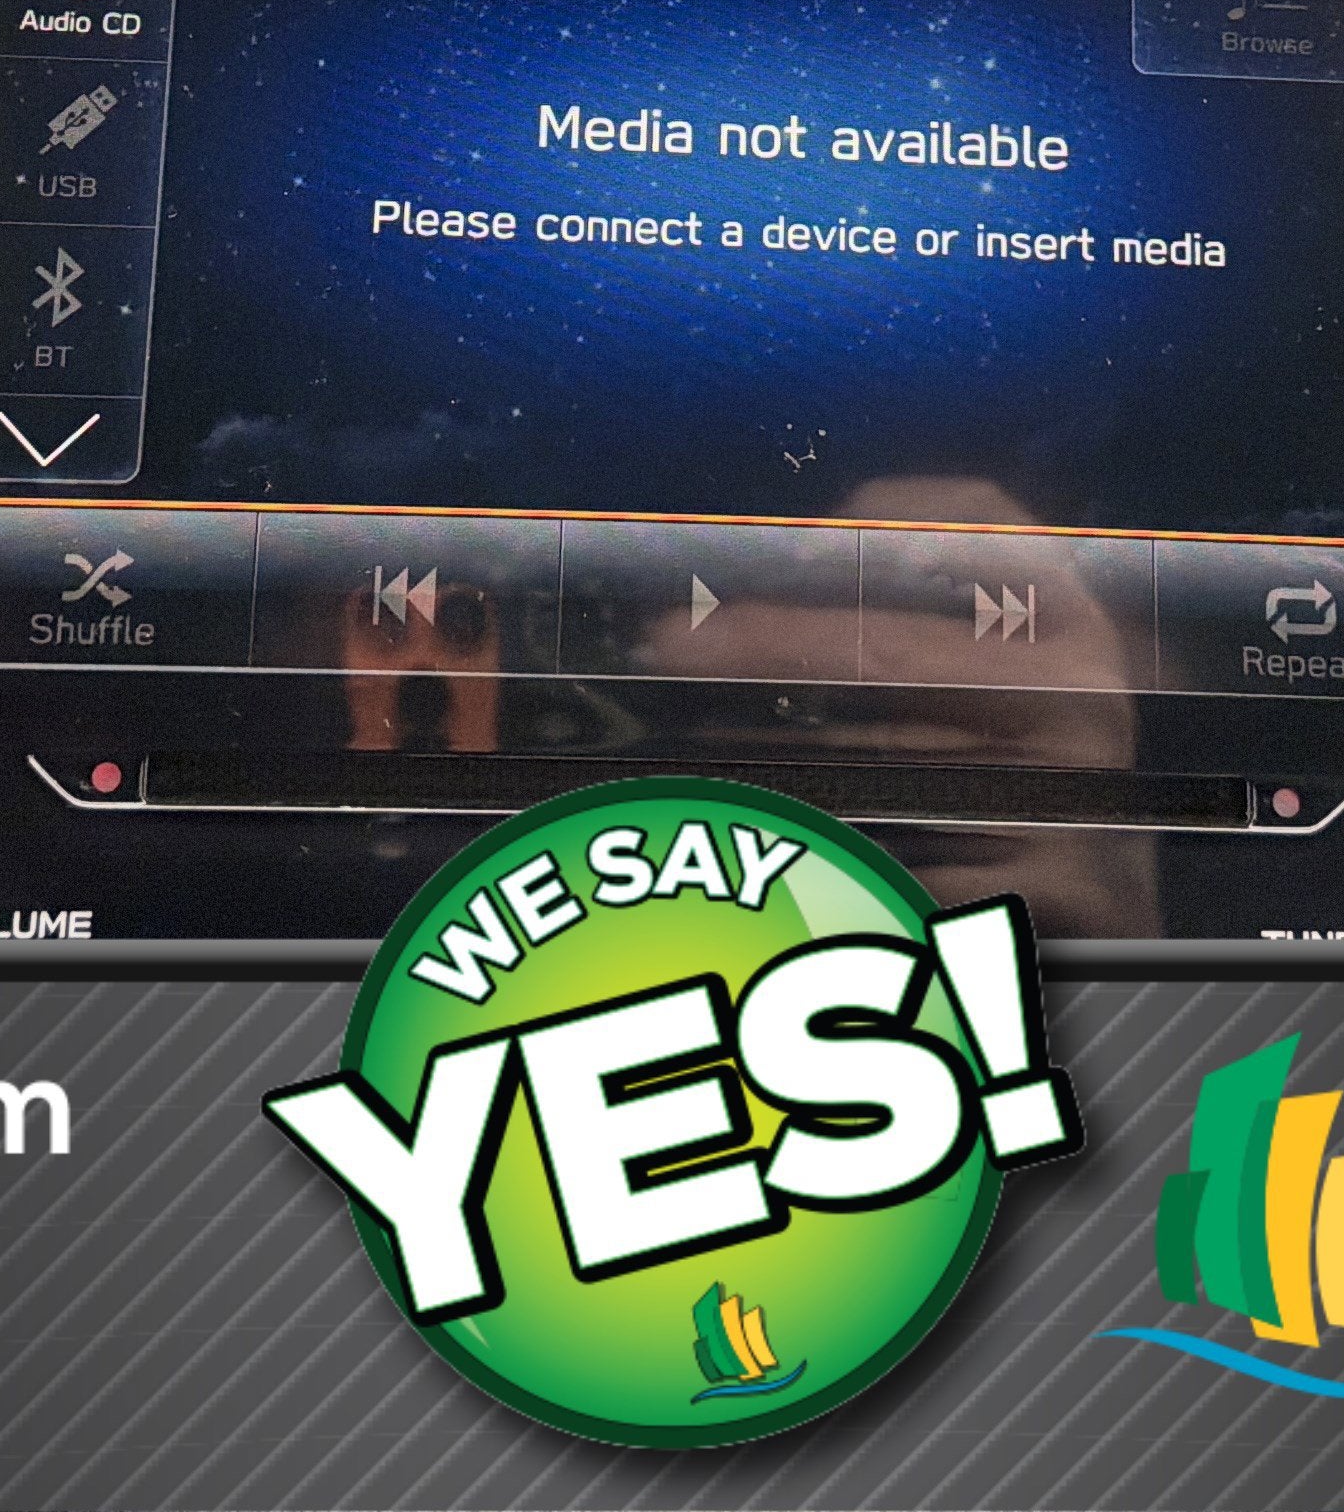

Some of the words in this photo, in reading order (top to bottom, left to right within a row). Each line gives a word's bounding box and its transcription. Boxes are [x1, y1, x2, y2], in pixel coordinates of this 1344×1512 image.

[19, 9, 92, 35] Audio
[102, 11, 142, 36] CD
[1221, 30, 1315, 57] Browse
[538, 104, 694, 156] Media
[719, 114, 807, 161] not
[831, 121, 1070, 172] available
[38, 174, 98, 200] USB
[372, 199, 517, 242] Please
[535, 207, 704, 249] connect
[720, 223, 744, 248] a
[762, 216, 896, 257] device
[915, 227, 959, 257] or
[976, 224, 1095, 264] insert
[1113, 231, 1227, 268] media
[34, 345, 74, 369] BT
[29, 612, 156, 647] Shuffle
